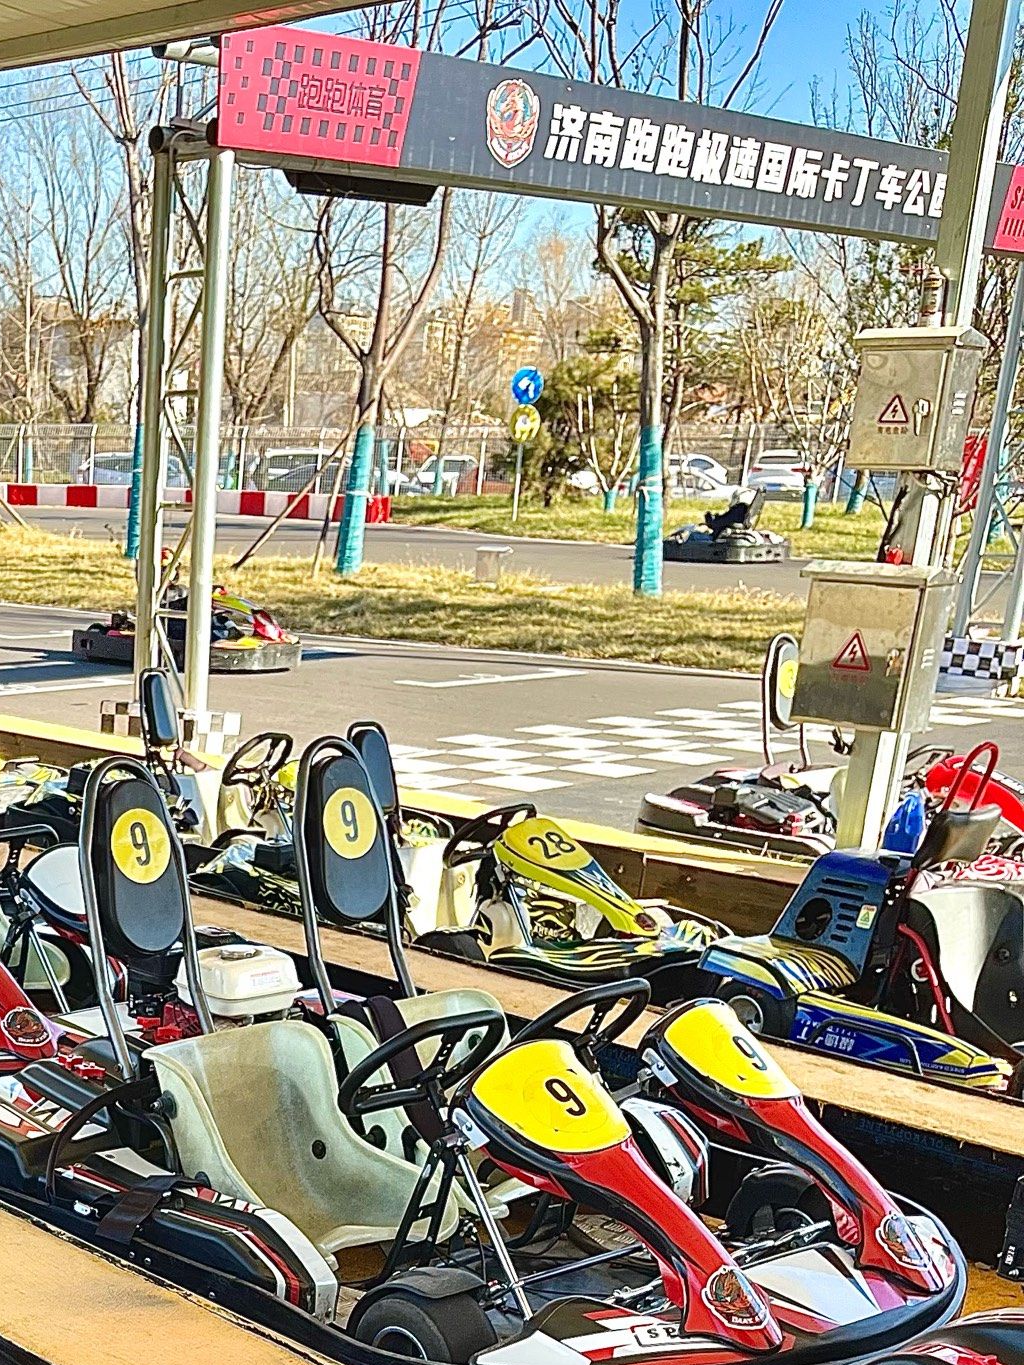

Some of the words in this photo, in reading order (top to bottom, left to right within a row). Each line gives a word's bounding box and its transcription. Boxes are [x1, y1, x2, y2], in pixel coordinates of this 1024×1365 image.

[298, 73, 386, 121] 跑跑体育
[339, 800, 360, 843] 9
[129, 820, 151, 867] 9
[527, 830, 577, 861] 28
[731, 1034, 768, 1073] 9
[543, 1077, 588, 1118] 9
